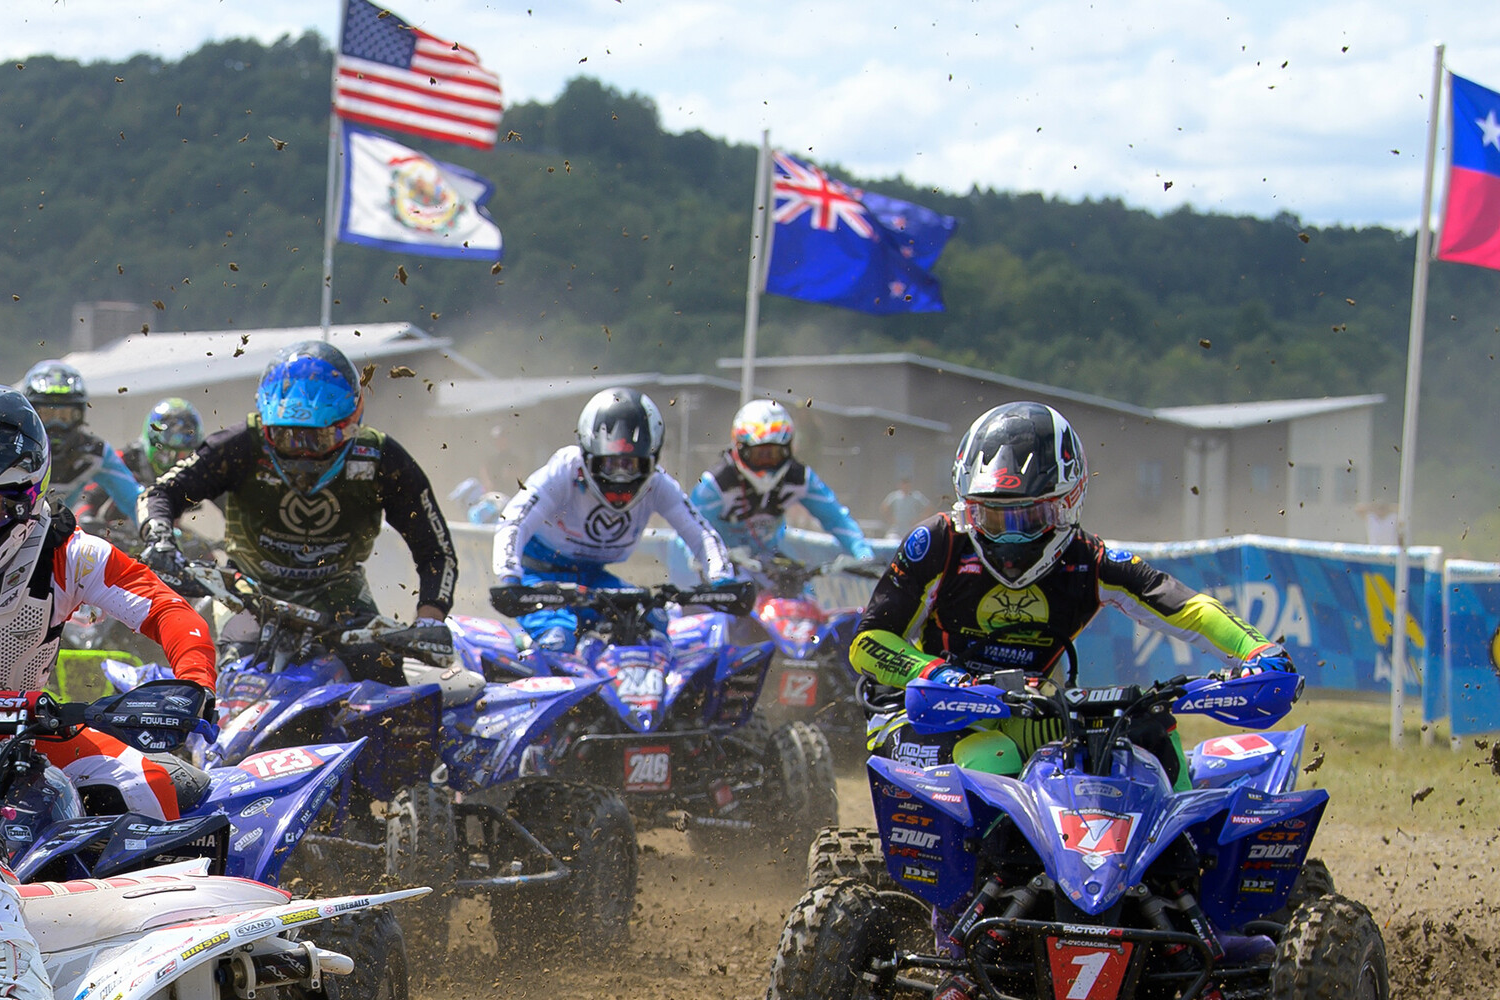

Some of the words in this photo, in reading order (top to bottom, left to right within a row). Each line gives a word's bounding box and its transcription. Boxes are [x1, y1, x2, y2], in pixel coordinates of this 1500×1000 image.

[279, 564, 339, 579] YAMAHA
[984, 645, 1034, 662] YAMAHA
[932, 701, 1002, 714] ACERBIS
[1181, 696, 1248, 711] ACERBIS
[141, 716, 180, 726] FOWLER
[899, 742, 941, 758] MOOSE
[1213, 737, 1247, 754] 1
[244, 748, 313, 777] 723
[628, 754, 669, 783] 246
[933, 794, 962, 803] MOTUL
[891, 813, 933, 827] CST
[1233, 816, 1262, 824] MOTUL
[890, 827, 941, 849] DWT
[1077, 818, 1115, 850] 1
[1257, 832, 1301, 842] CST
[1248, 845, 1302, 858] DWT
[905, 866, 936, 877] DP
[334, 898, 371, 912] TIREBALLS
[237, 920, 272, 937] EVANS
[1063, 926, 1111, 935] FACTORY
[182, 931, 231, 961] HINSON
[1066, 951, 1111, 1000] 1
